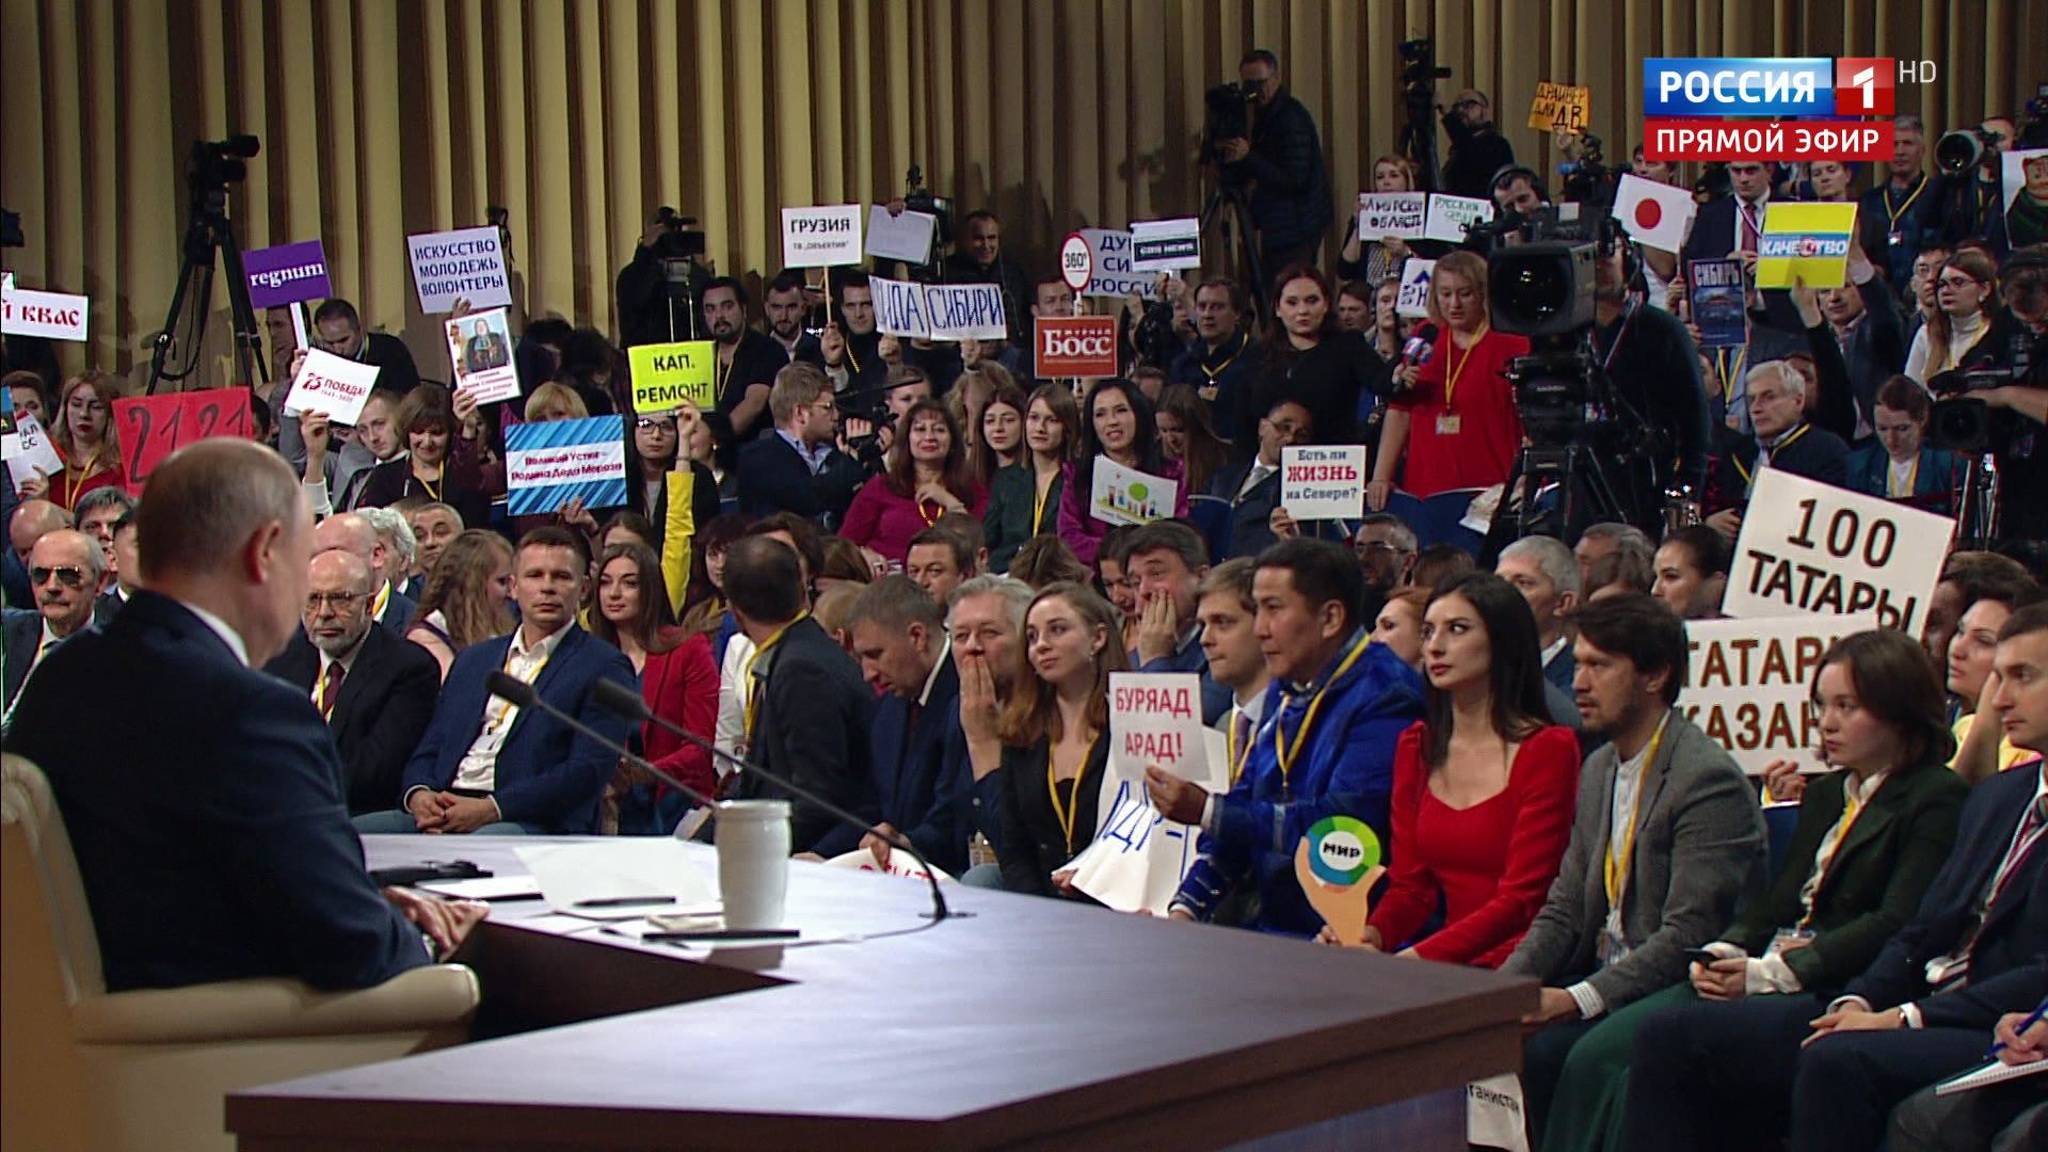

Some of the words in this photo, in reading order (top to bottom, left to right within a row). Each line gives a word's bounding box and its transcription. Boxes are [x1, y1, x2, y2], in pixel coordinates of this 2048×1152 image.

[790, 218, 850, 233] ГРУЗИЯ
[415, 240, 496, 261] ИСКУССТВО
[1100, 235, 1132, 252] ДУ
[249, 262, 325, 288] regnum
[419, 258, 498, 278] МОЛОДЕЖЬ
[421, 275, 504, 297] ВОЛОНТЕРЫ
[1091, 279, 1157, 295] РОССИ
[927, 287, 1004, 329] СИБИРИ
[653, 355, 695, 371] КАП.
[637, 382, 708, 404] РЕМОНТ
[1298, 450, 1327, 461] Есть
[1288, 466, 1357, 482] ЖИЗНЬ
[1286, 491, 1300, 499] на
[1303, 488, 1357, 501] Севере?
[1787, 498, 1897, 568] 100
[1747, 549, 1917, 633] ТАТАРЫ
[1680, 635, 1838, 688] АТАР
[1115, 686, 1191, 718] БУРЯАД
[1125, 733, 1182, 763] АРАД!
[1323, 843, 1360, 858] МИР
